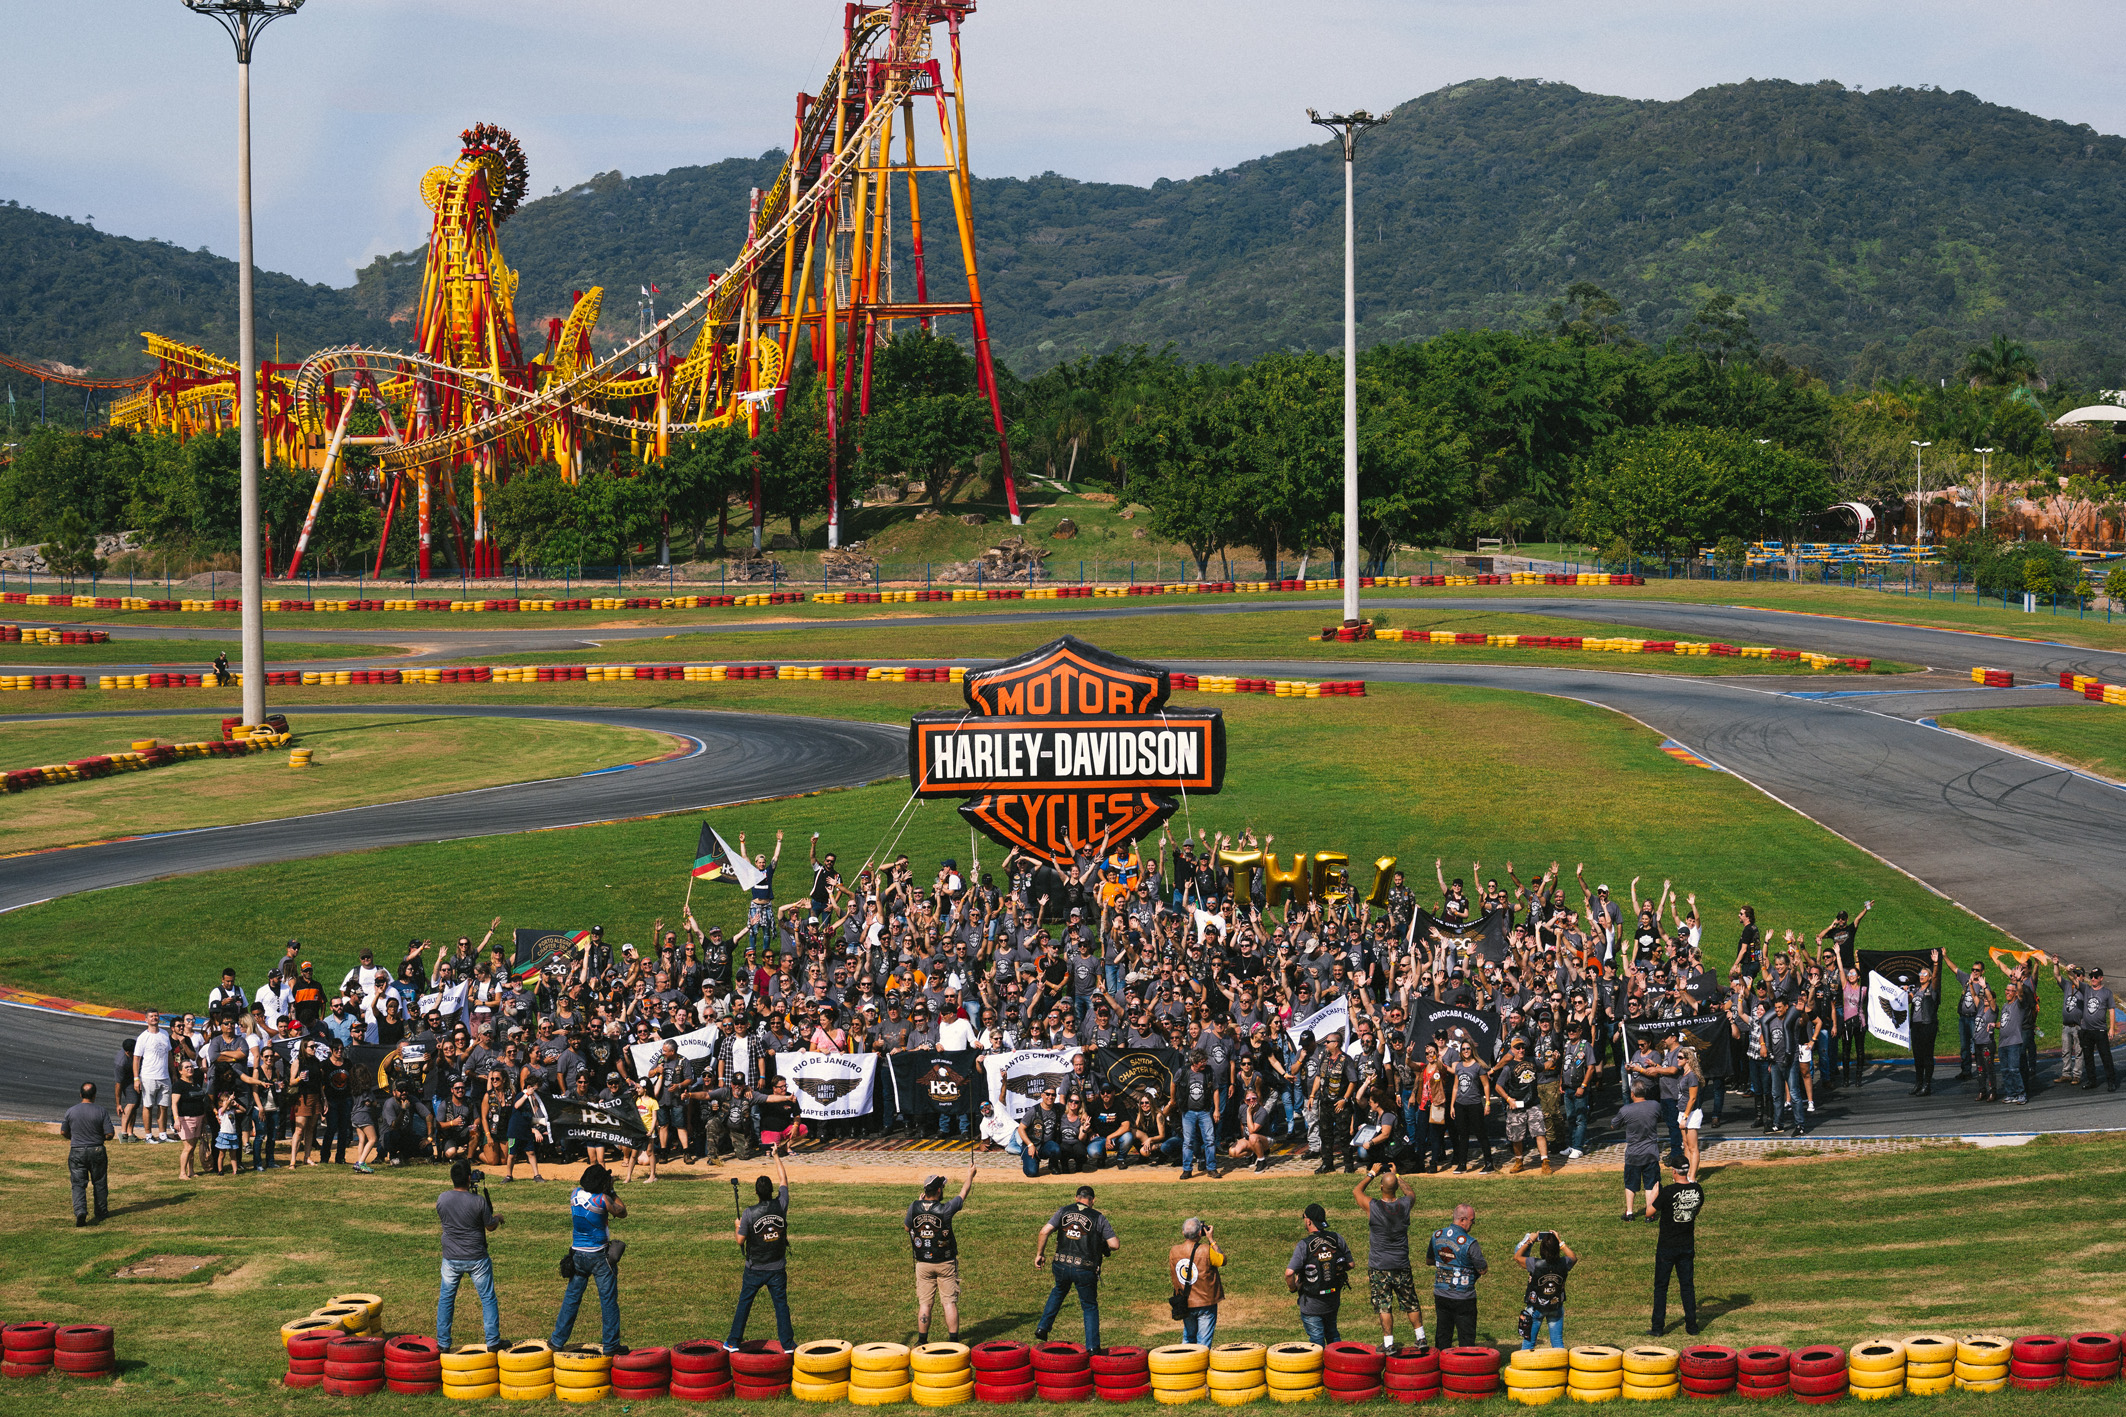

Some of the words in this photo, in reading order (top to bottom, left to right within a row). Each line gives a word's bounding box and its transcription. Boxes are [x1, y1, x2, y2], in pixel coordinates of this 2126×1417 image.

[998, 663, 1134, 716] MOTOR
[934, 730, 1198, 779] HARLEY-DAVIDSON
[996, 793, 1134, 858] CYCLES
[721, 863, 738, 876] HO
[1219, 850, 1350, 907] THE
[1428, 1009, 1463, 1022] SOROCABA
[1463, 1012, 1489, 1034] CHAPTER
[1638, 1021, 1676, 1031] AUTOSTAR
[1677, 1018, 1692, 1027] SÃO
[1693, 1016, 1718, 1024] PAULO
[680, 1039, 712, 1049] LONDRINA
[649, 1053, 660, 1065] RED
[792, 1060, 808, 1074] RIO
[809, 1056, 822, 1065] DE
[824, 1057, 863, 1074] JANEIRO
[1032, 1052, 1070, 1069] CHAPTER
[1118, 1066, 1149, 1083] CHAPTER
[930, 1080, 958, 1095] HOG
[1027, 1079, 1045, 1087] LADIES
[800, 1108, 829, 1117] HAPTER
[830, 1108, 859, 1116] BRASIL
[567, 1128, 608, 1140] CHAPTER
[608, 1133, 633, 1146] BRASIL
[763, 1232, 779, 1241] HOG
[1318, 1251, 1332, 1260] HOG
